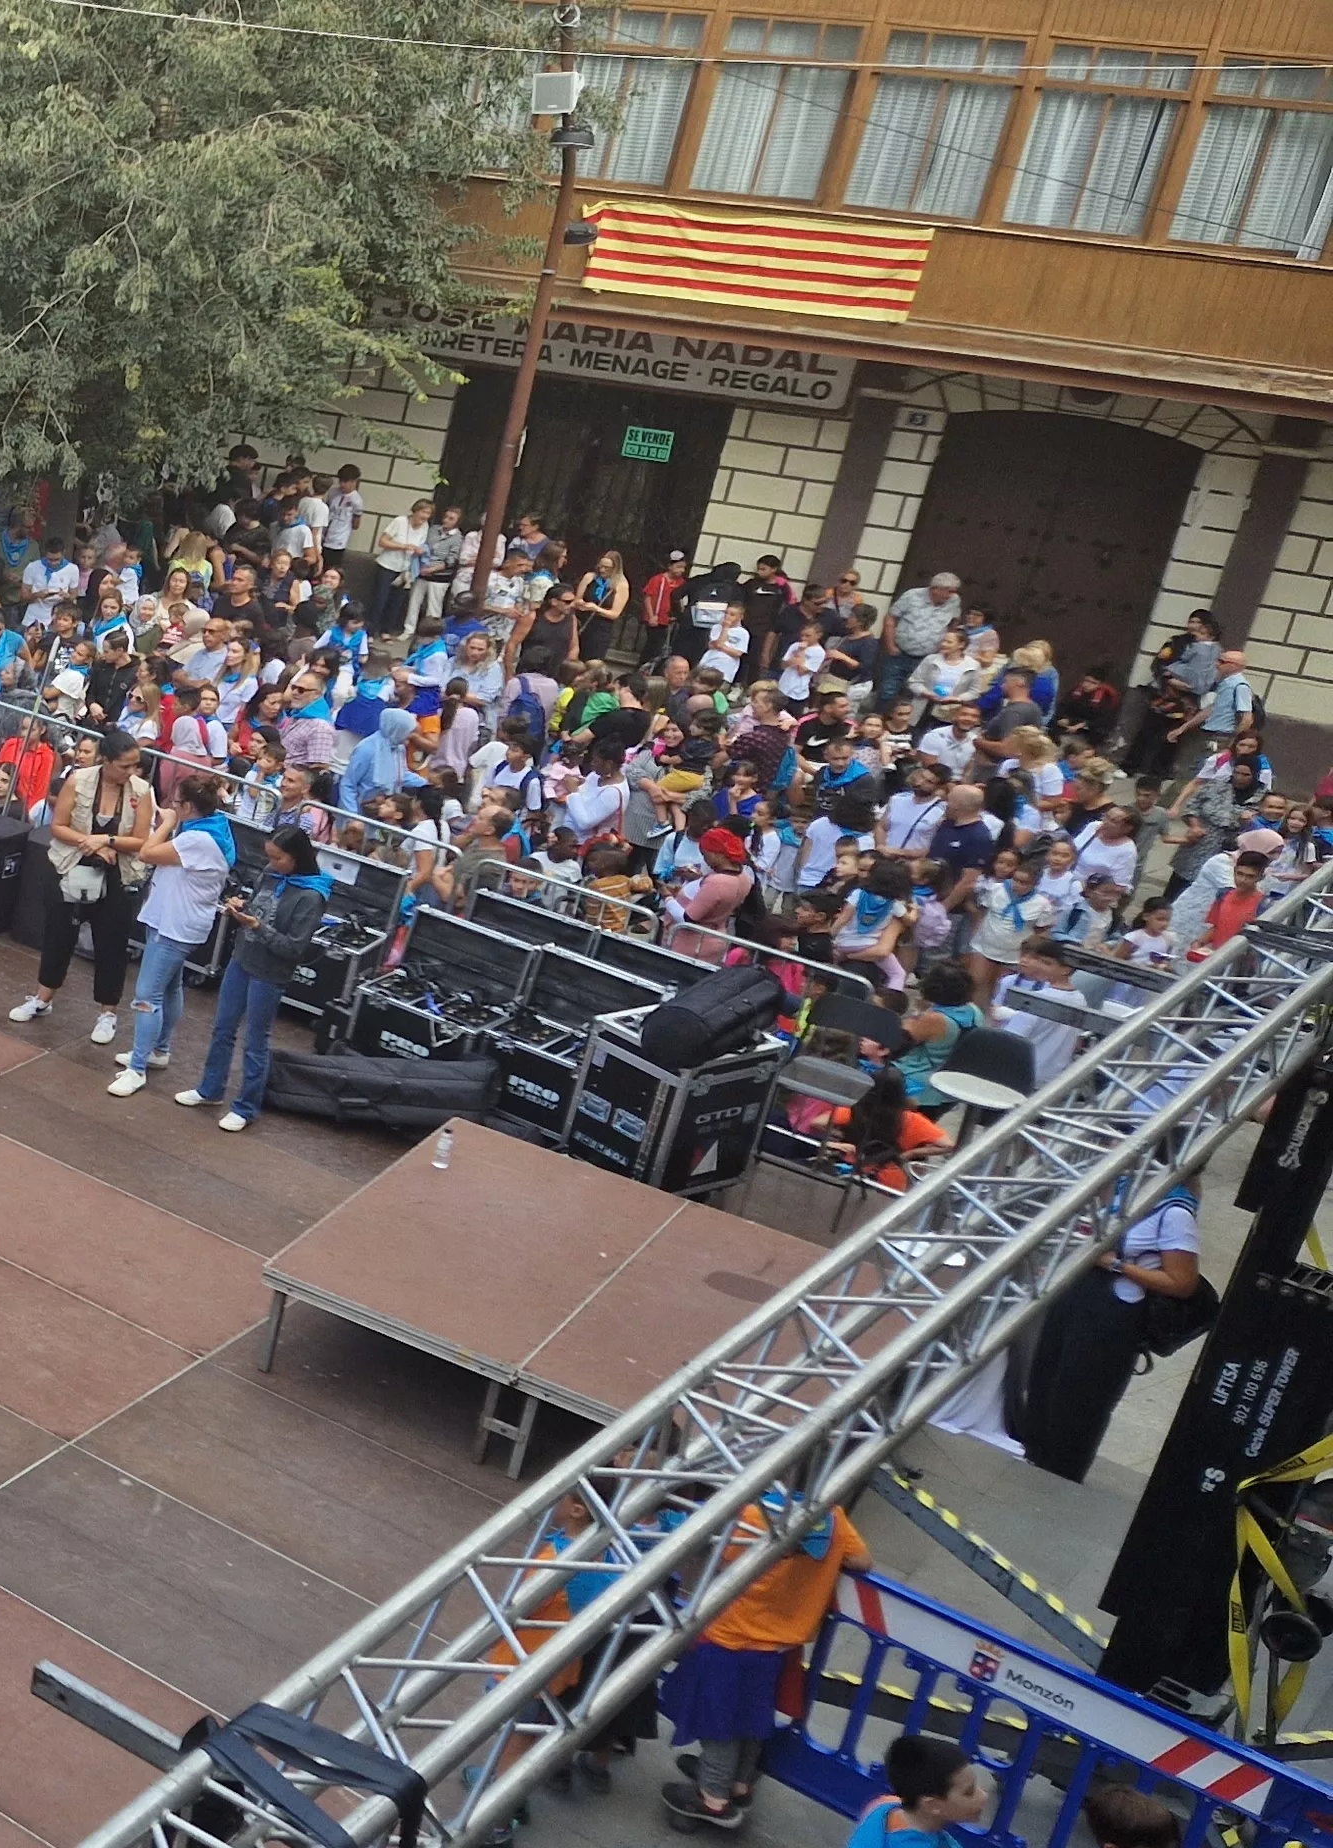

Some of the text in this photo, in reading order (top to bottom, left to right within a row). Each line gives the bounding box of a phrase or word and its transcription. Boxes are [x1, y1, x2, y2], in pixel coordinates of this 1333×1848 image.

[569, 348, 690, 382] MENAGE
[707, 367, 833, 400] REGALO
[672, 336, 838, 376] NADAL
[628, 429, 672, 447] SE VENDE
[1211, 1361, 1242, 1406] LIFTISA
[1233, 1403, 1251, 1426] 902
[1242, 1381, 1260, 1402] 100
[1258, 1387, 1283, 1427] SUPER
[1273, 1347, 1301, 1390] TOWER
[1005, 1668, 1075, 1711] Monzón
